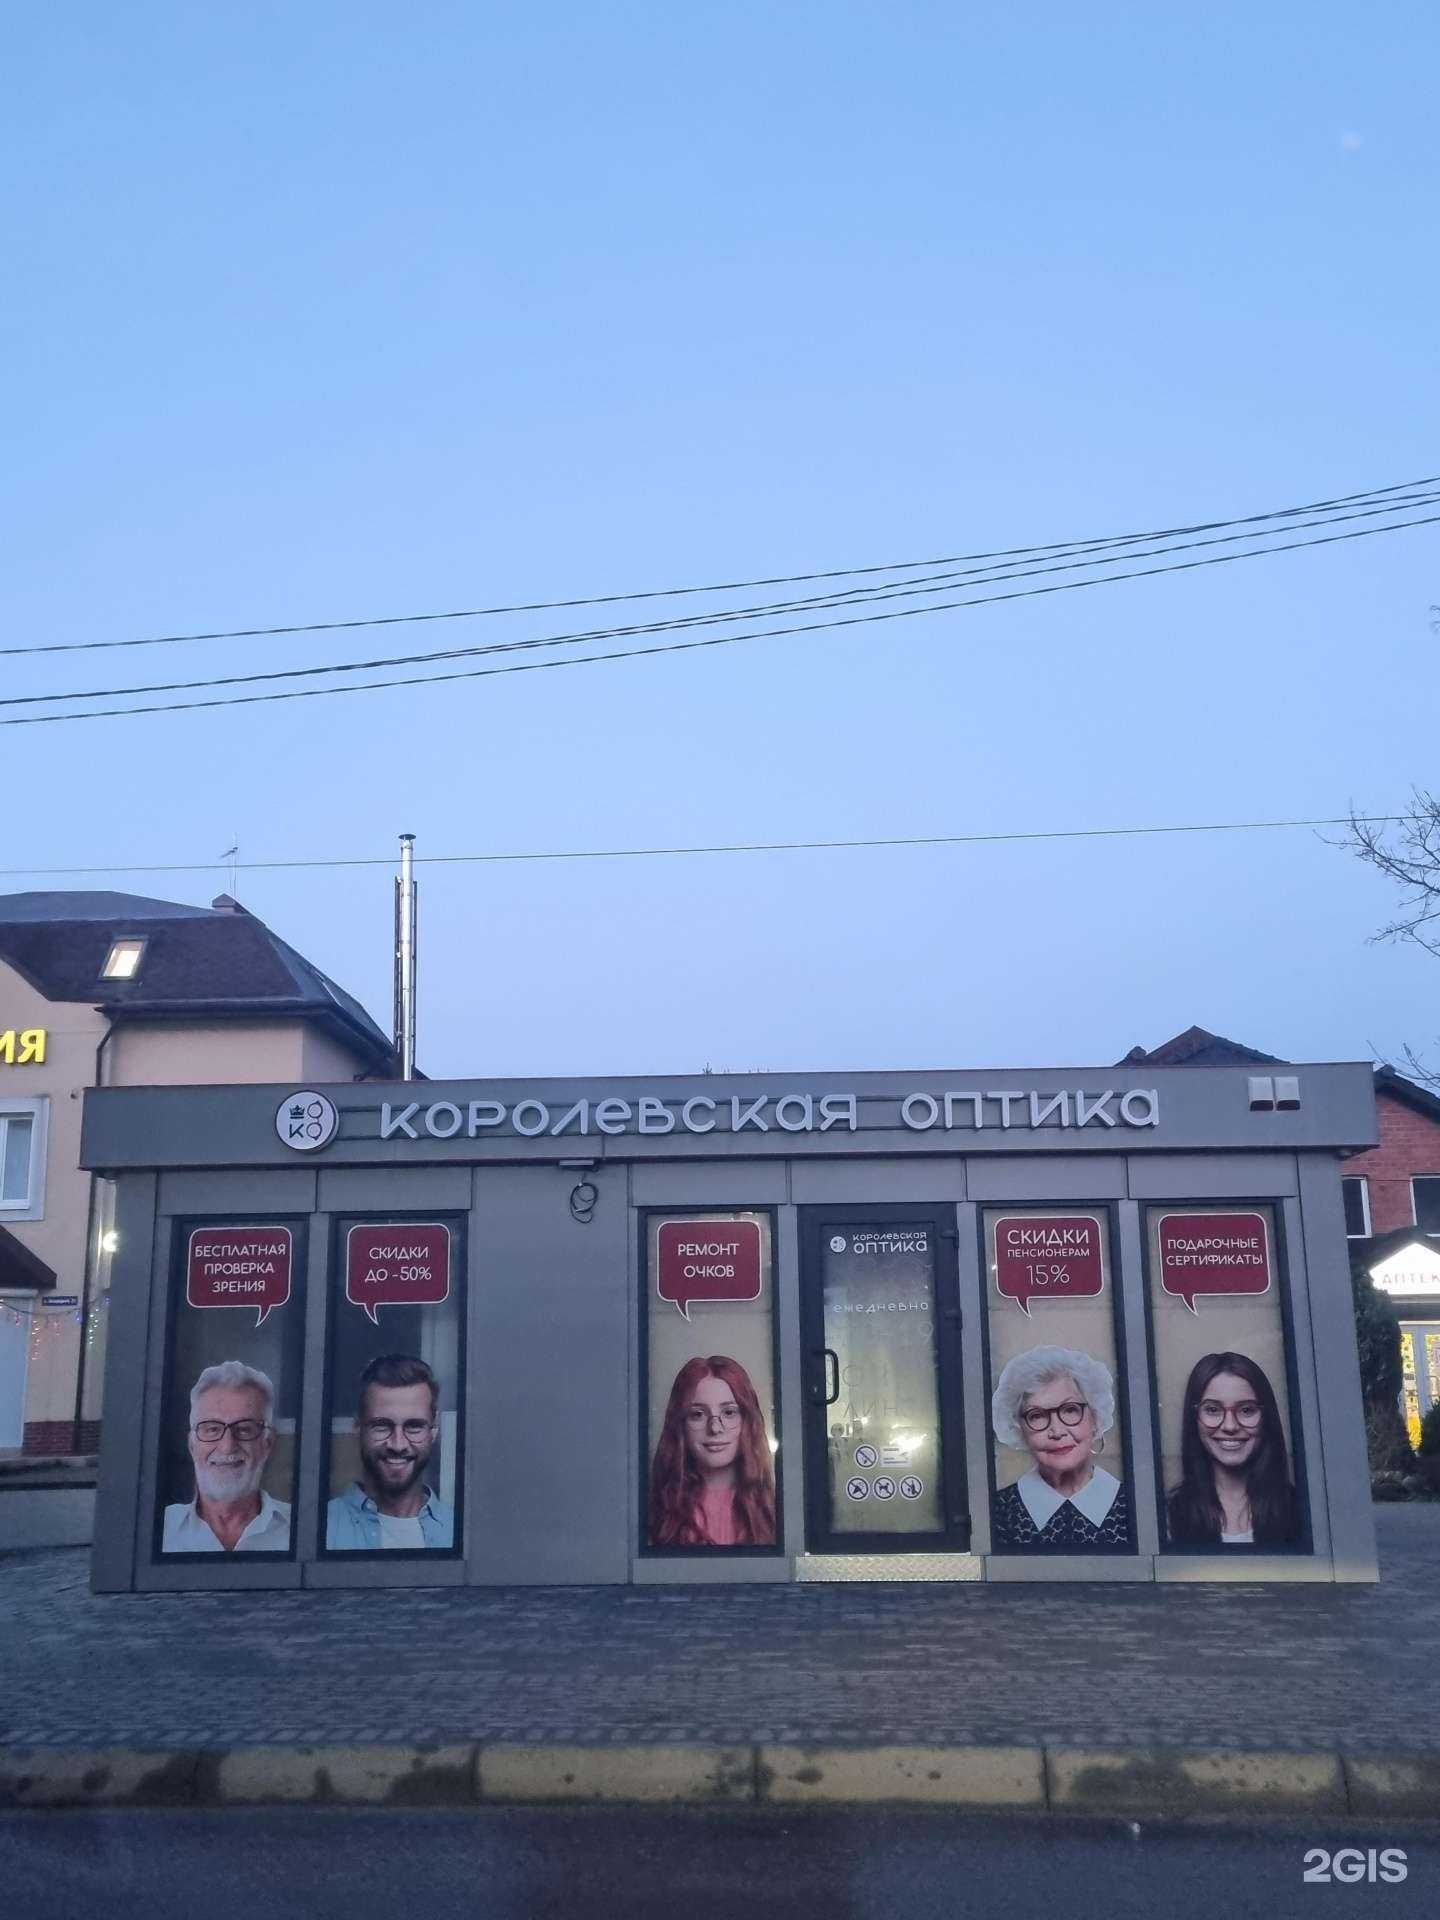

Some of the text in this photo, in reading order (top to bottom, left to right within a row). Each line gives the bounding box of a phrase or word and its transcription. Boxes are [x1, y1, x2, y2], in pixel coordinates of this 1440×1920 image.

[1007, 1228, 1090, 1247] СКИДКИ
[1167, 1237, 1259, 1251] ПОДАРОЧНЫЕ
[194, 1243, 286, 1258] БЕСПЛАТНАЯ
[369, 1246, 429, 1261] СКИДКИ
[677, 1242, 740, 1256] РЕМОНТ
[1007, 1247, 1090, 1258] ПЕНСИОНЕРАМ
[1165, 1253, 1264, 1267] СЕРТИФИКАТЫ
[204, 1262, 275, 1275] ПРОВЕРКА
[364, 1265, 432, 1283] ДО -50%
[683, 1264, 735, 1278] ОЧКОВ
[1026, 1264, 1070, 1286] 15%
[212, 1280, 265, 1293] ЗРЕНИЯ
